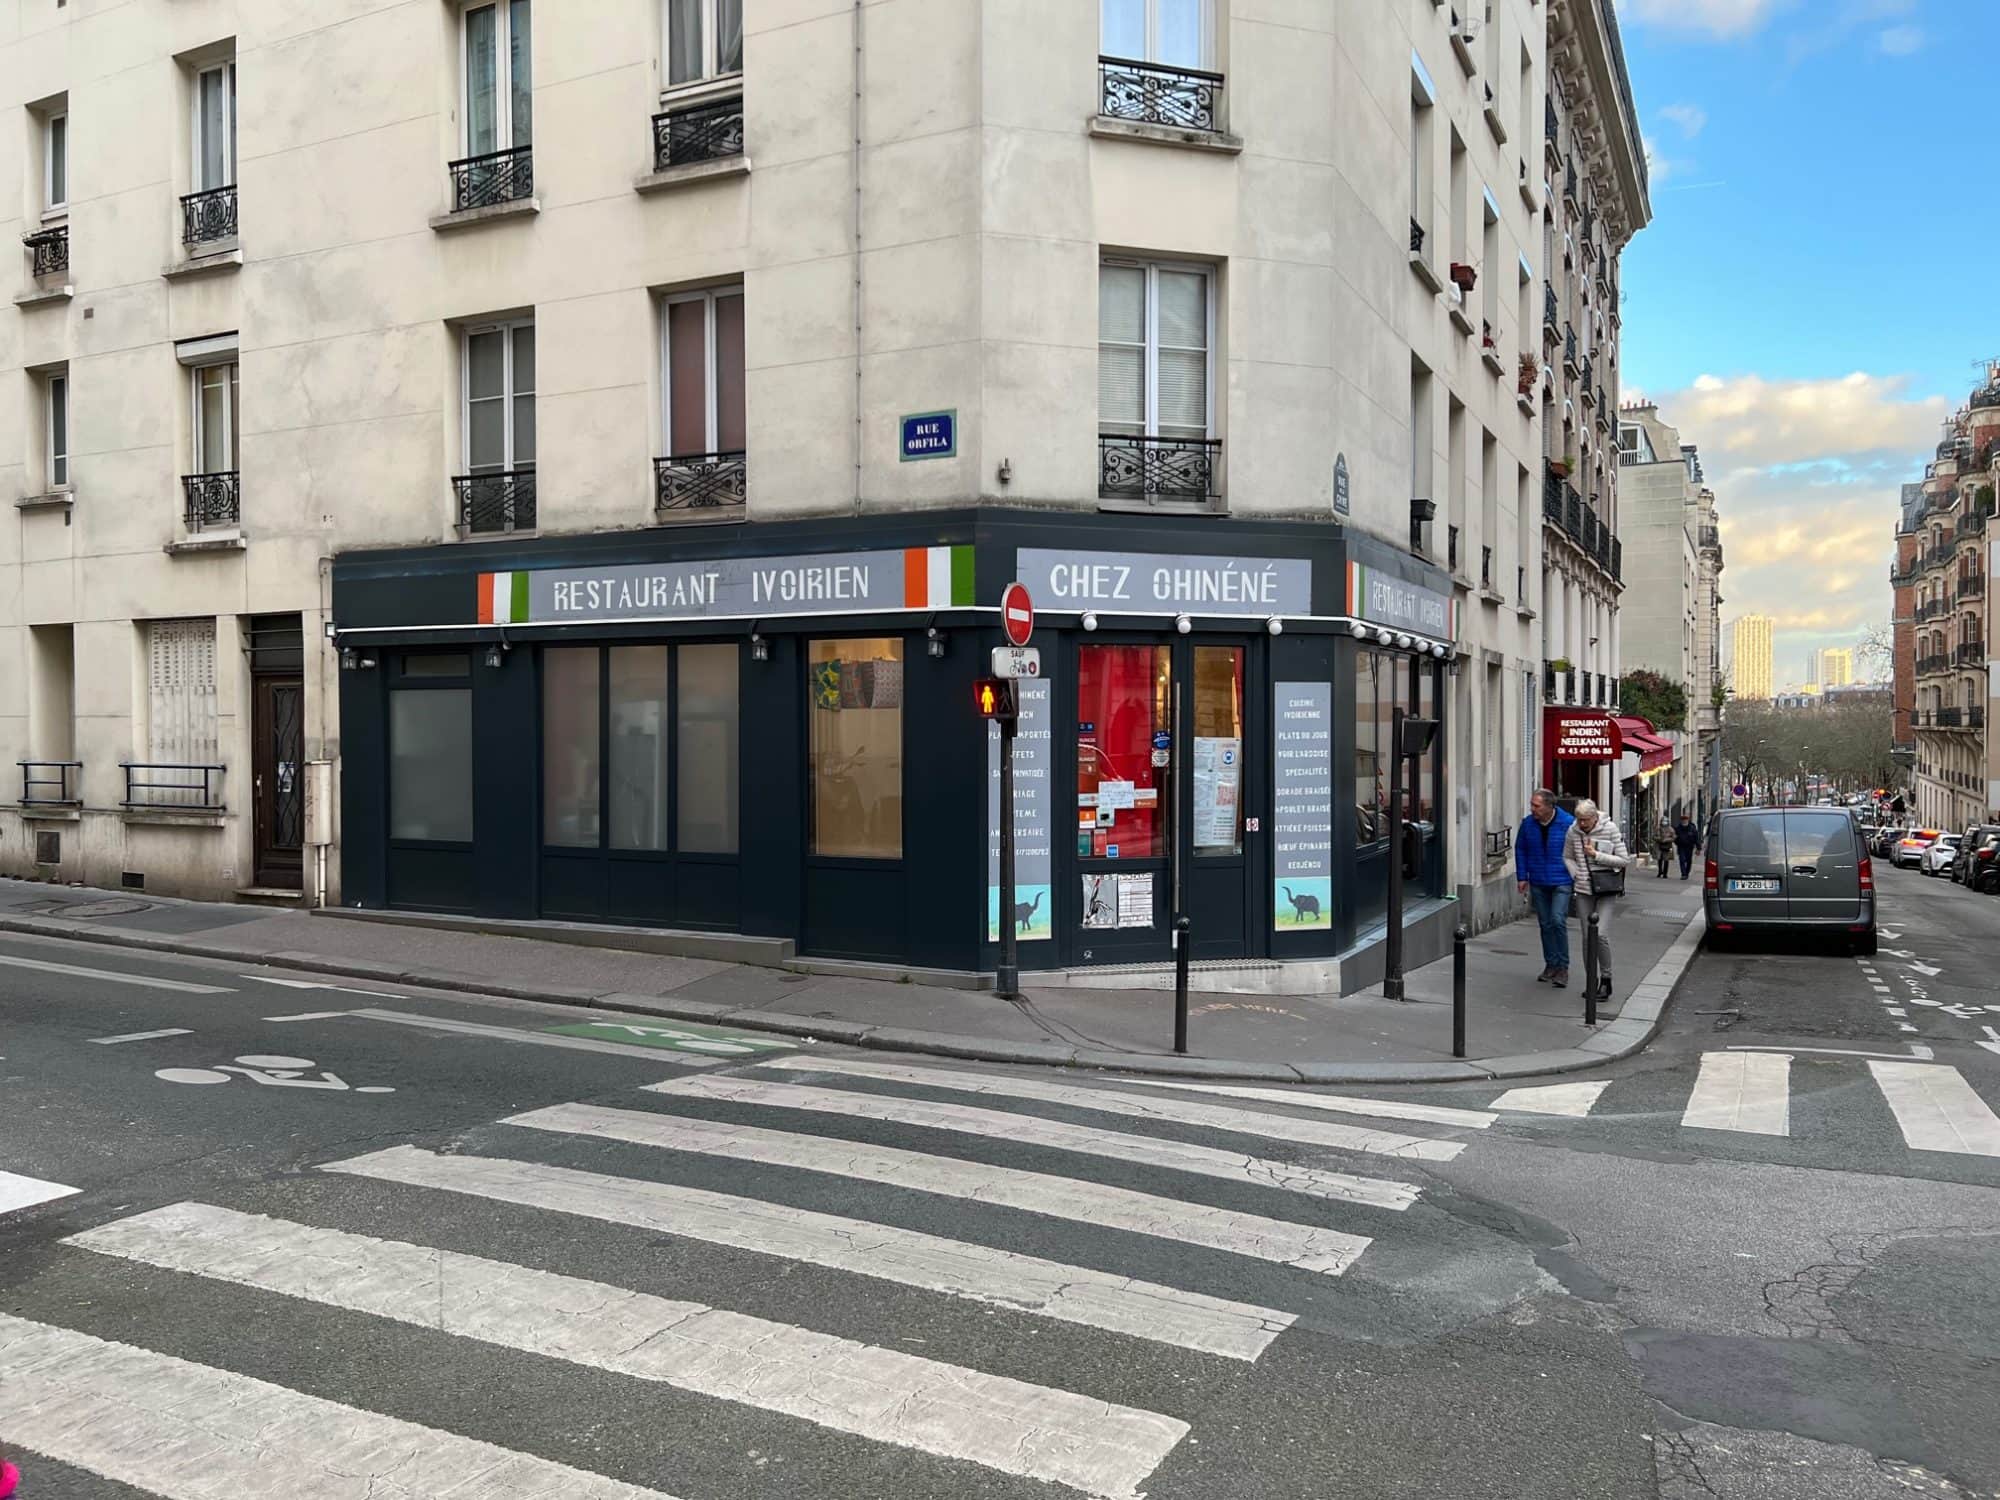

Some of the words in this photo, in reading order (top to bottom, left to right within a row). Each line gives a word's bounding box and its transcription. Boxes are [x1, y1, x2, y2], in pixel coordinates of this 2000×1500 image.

[916, 423, 940, 435] RUE
[908, 437, 948, 449] ORFILA
[1050, 564, 1131, 599] CHEZ
[1153, 561, 1278, 603] OHINÉNÉ
[553, 573, 720, 611] RESTAURANT
[752, 566, 869, 602] IVOIRIEN
[1372, 580, 1416, 621] RESTAURANT
[1010, 650, 1025, 658] SAUF
[1560, 719, 1610, 727] RESTAURANT
[1278, 731, 1300, 740] PLATS
[1569, 728, 1601, 736] INDIEN
[1560, 737, 1610, 746] NEELKANTH
